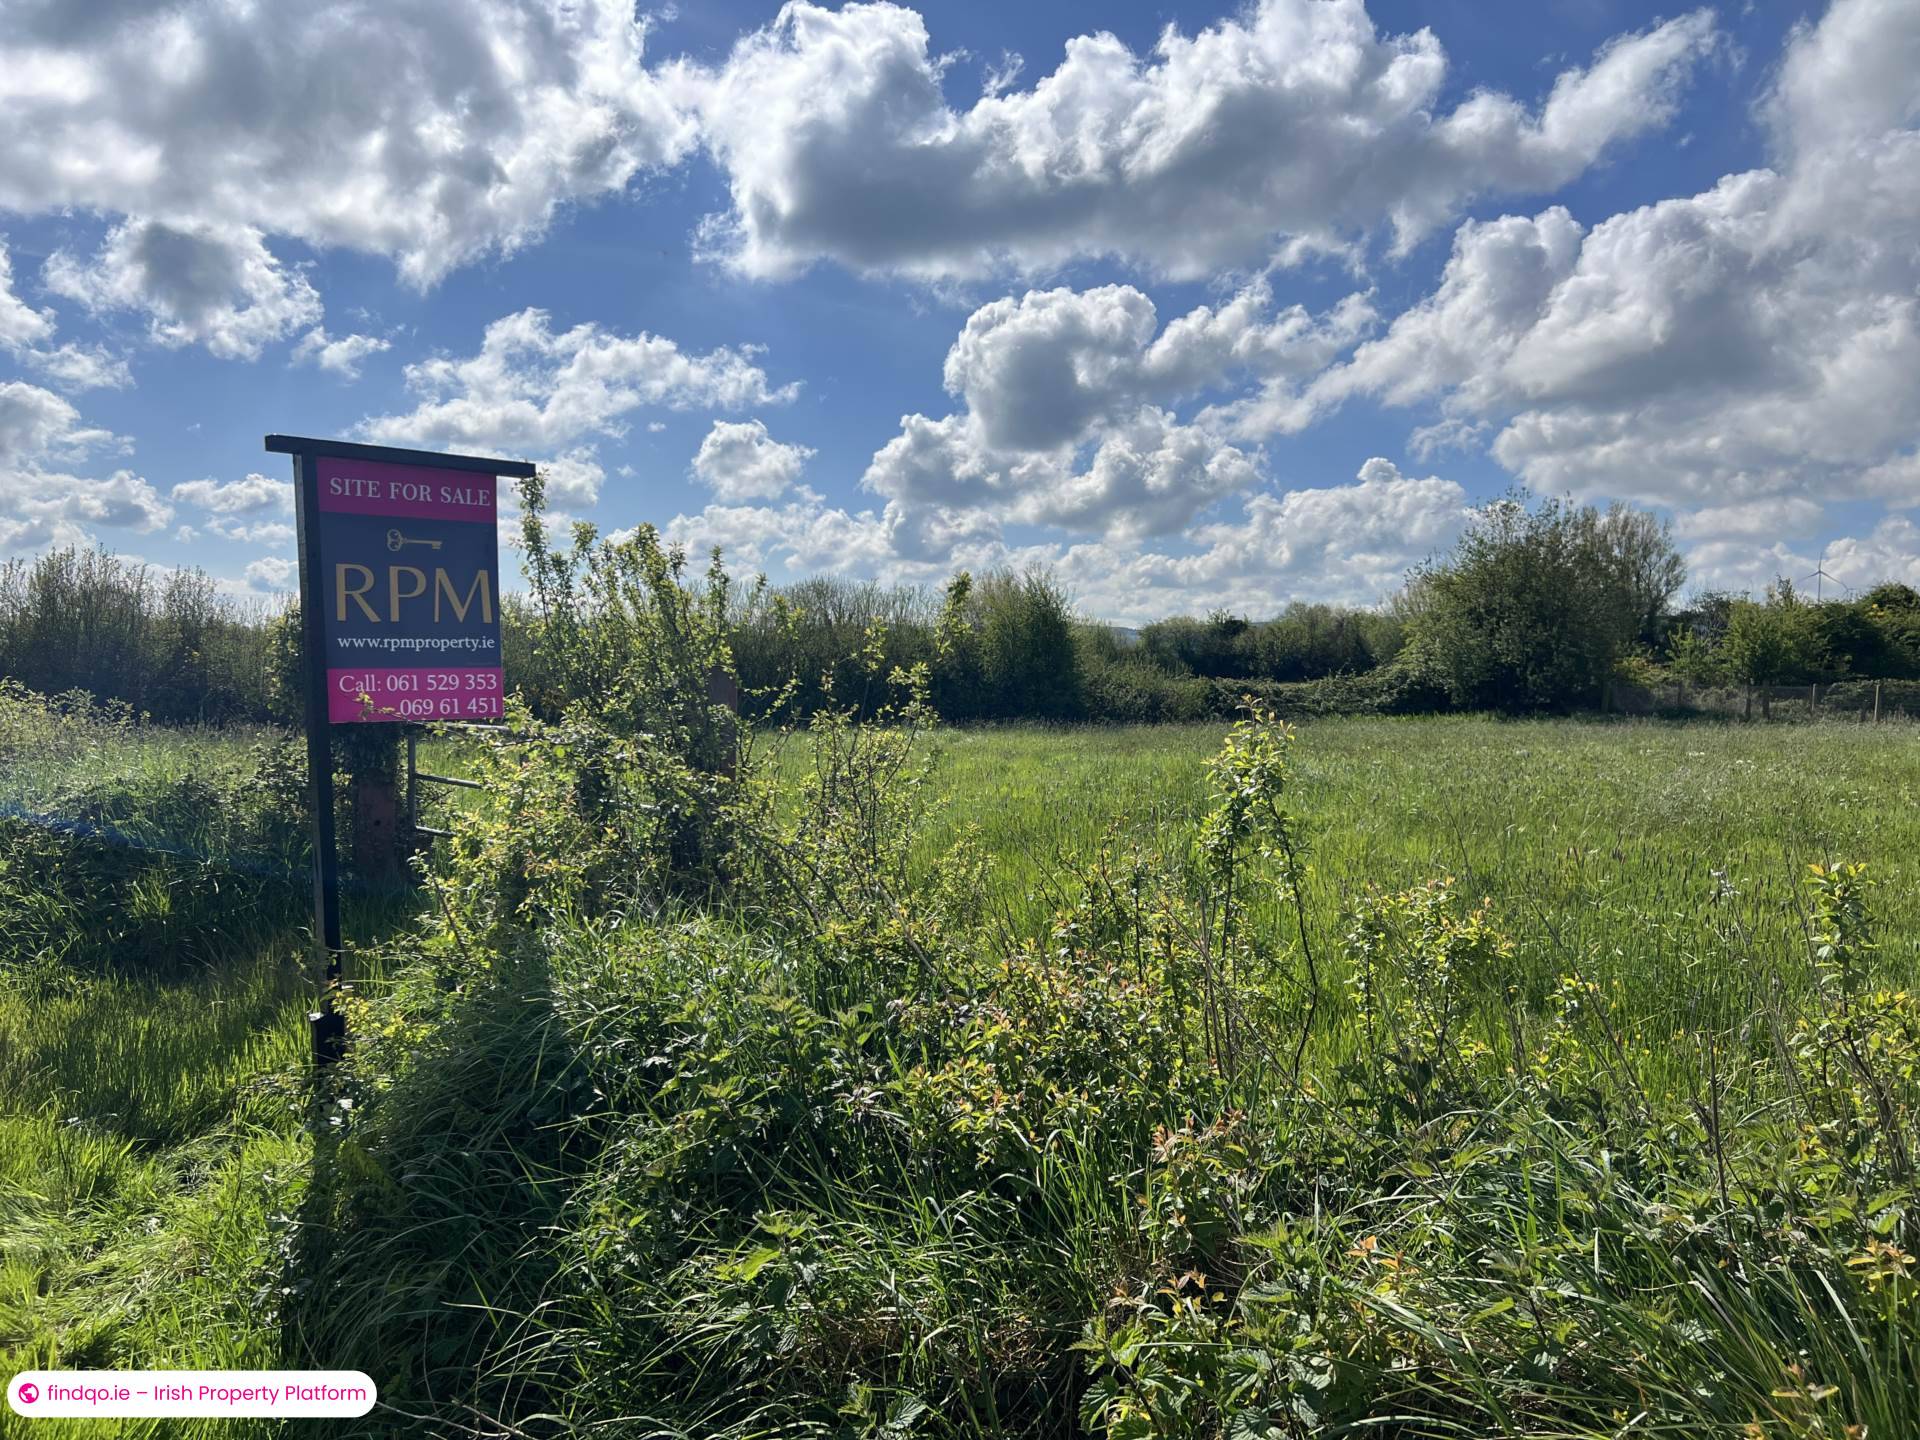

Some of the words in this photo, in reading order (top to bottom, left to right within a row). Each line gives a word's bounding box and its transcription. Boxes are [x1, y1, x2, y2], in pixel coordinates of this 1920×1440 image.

[330, 477, 380, 498] SITE
[389, 482, 432, 502] FOR
[440, 486, 491, 506] SALE
[335, 563, 493, 624] RPM
[337, 636, 495, 652] www.rpmproperty.ie
[339, 674, 381, 693] Call:
[386, 674, 419, 692] 061
[427, 674, 460, 691] 529
[464, 673, 497, 690] 353
[400, 698, 433, 716] 069
[439, 698, 460, 715] 61
[467, 697, 498, 714] 451
